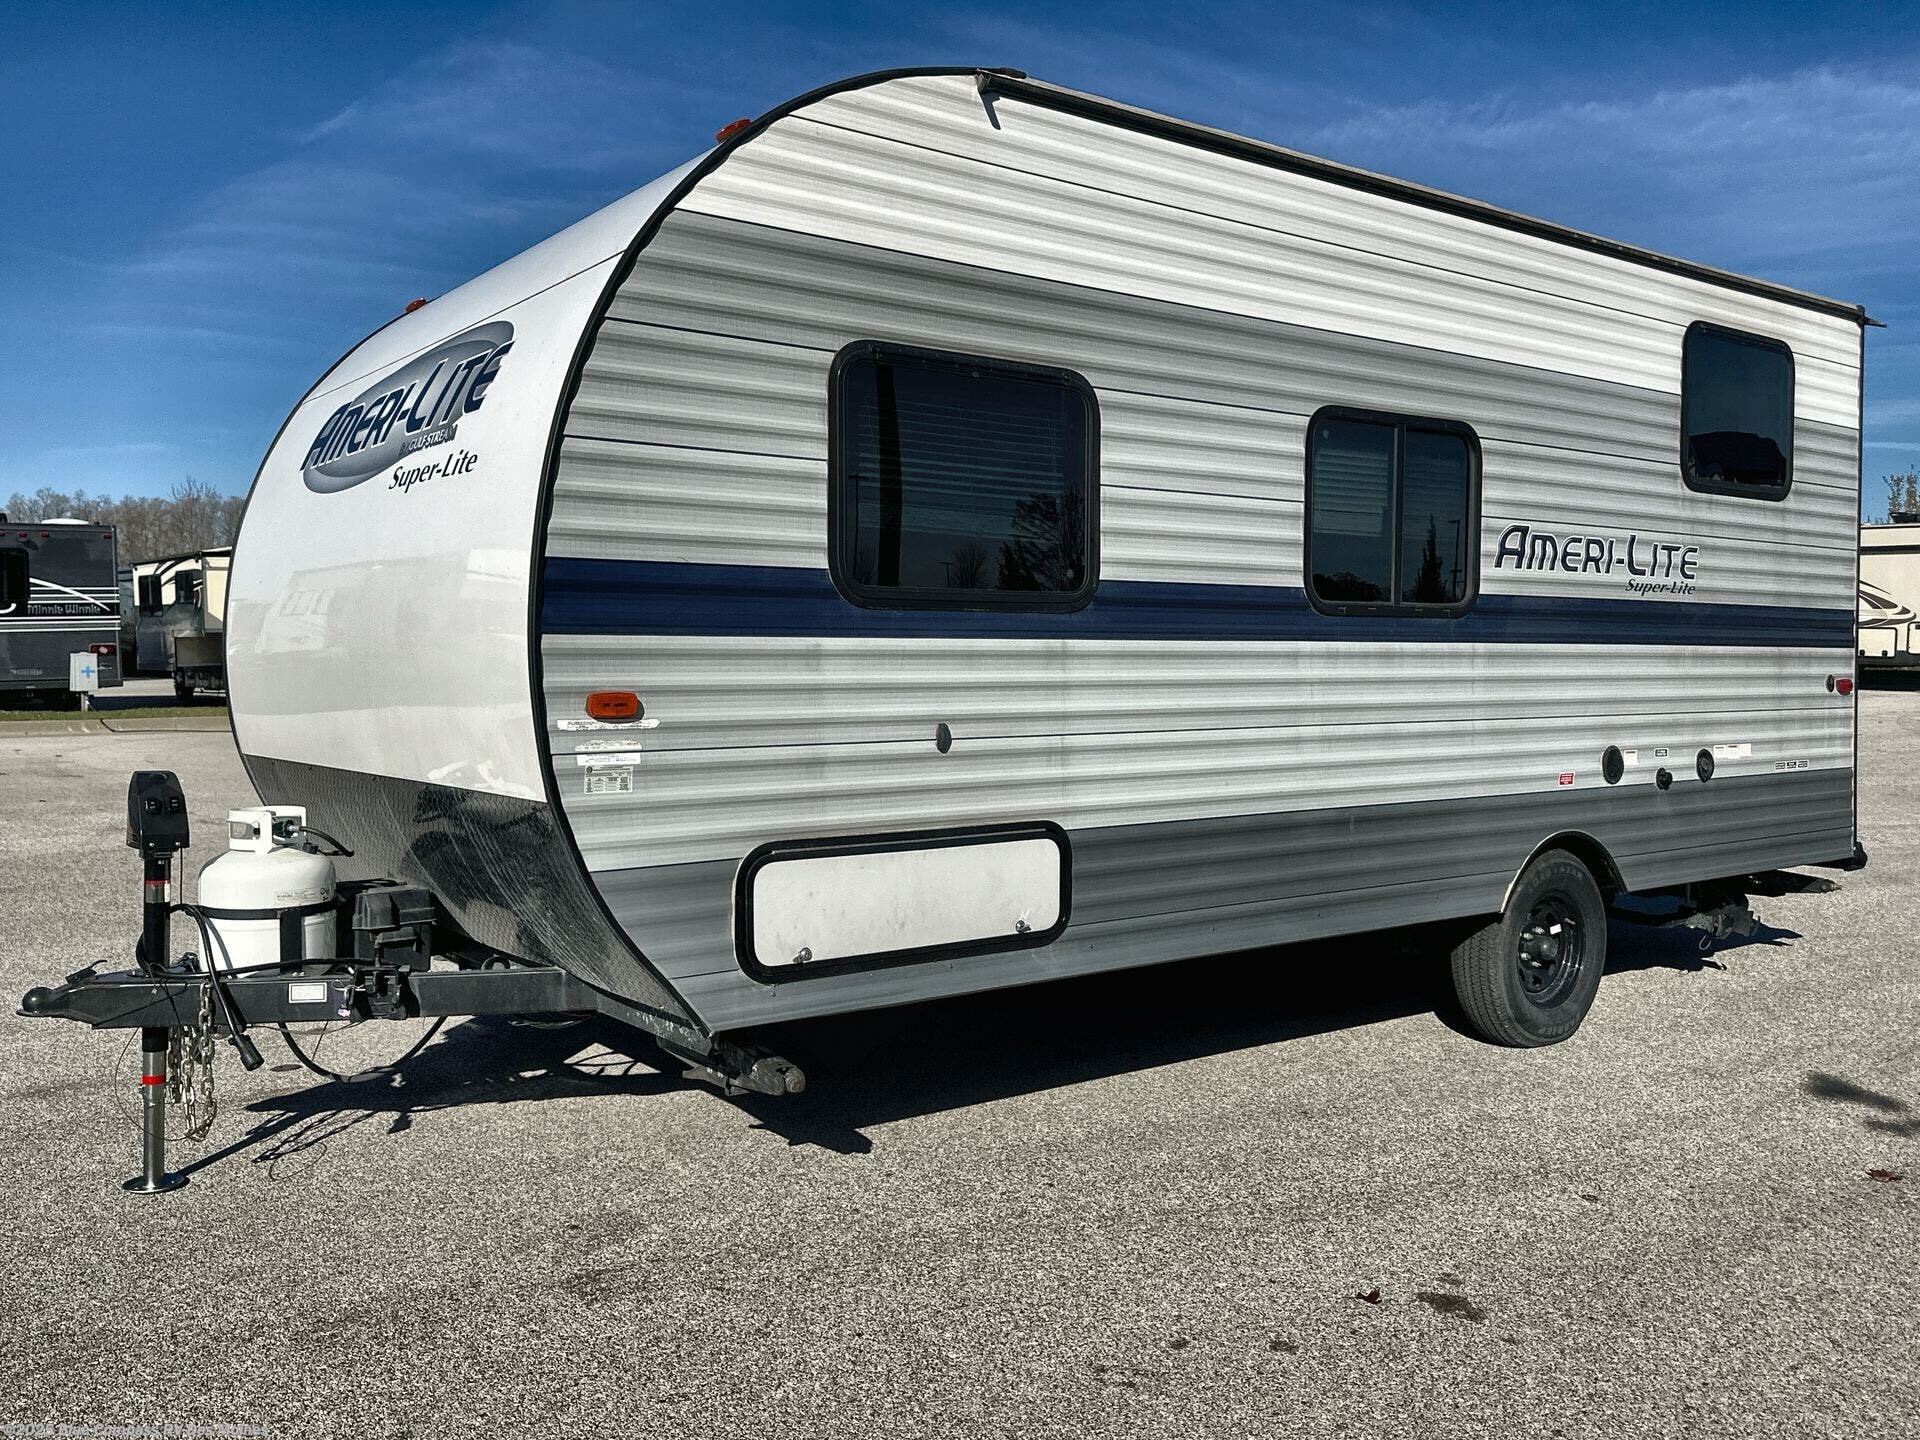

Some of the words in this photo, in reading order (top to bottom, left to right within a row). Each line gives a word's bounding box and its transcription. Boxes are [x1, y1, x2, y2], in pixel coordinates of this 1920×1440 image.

[299, 340, 515, 471] AMERI-LITE
[388, 449, 478, 493] Super-Lite
[1494, 524, 1698, 580] AMERI-LITE
[1625, 578, 1696, 596] Super-Lite
[27, 604, 63, 615] Minnie
[65, 604, 101, 615] Winnie
